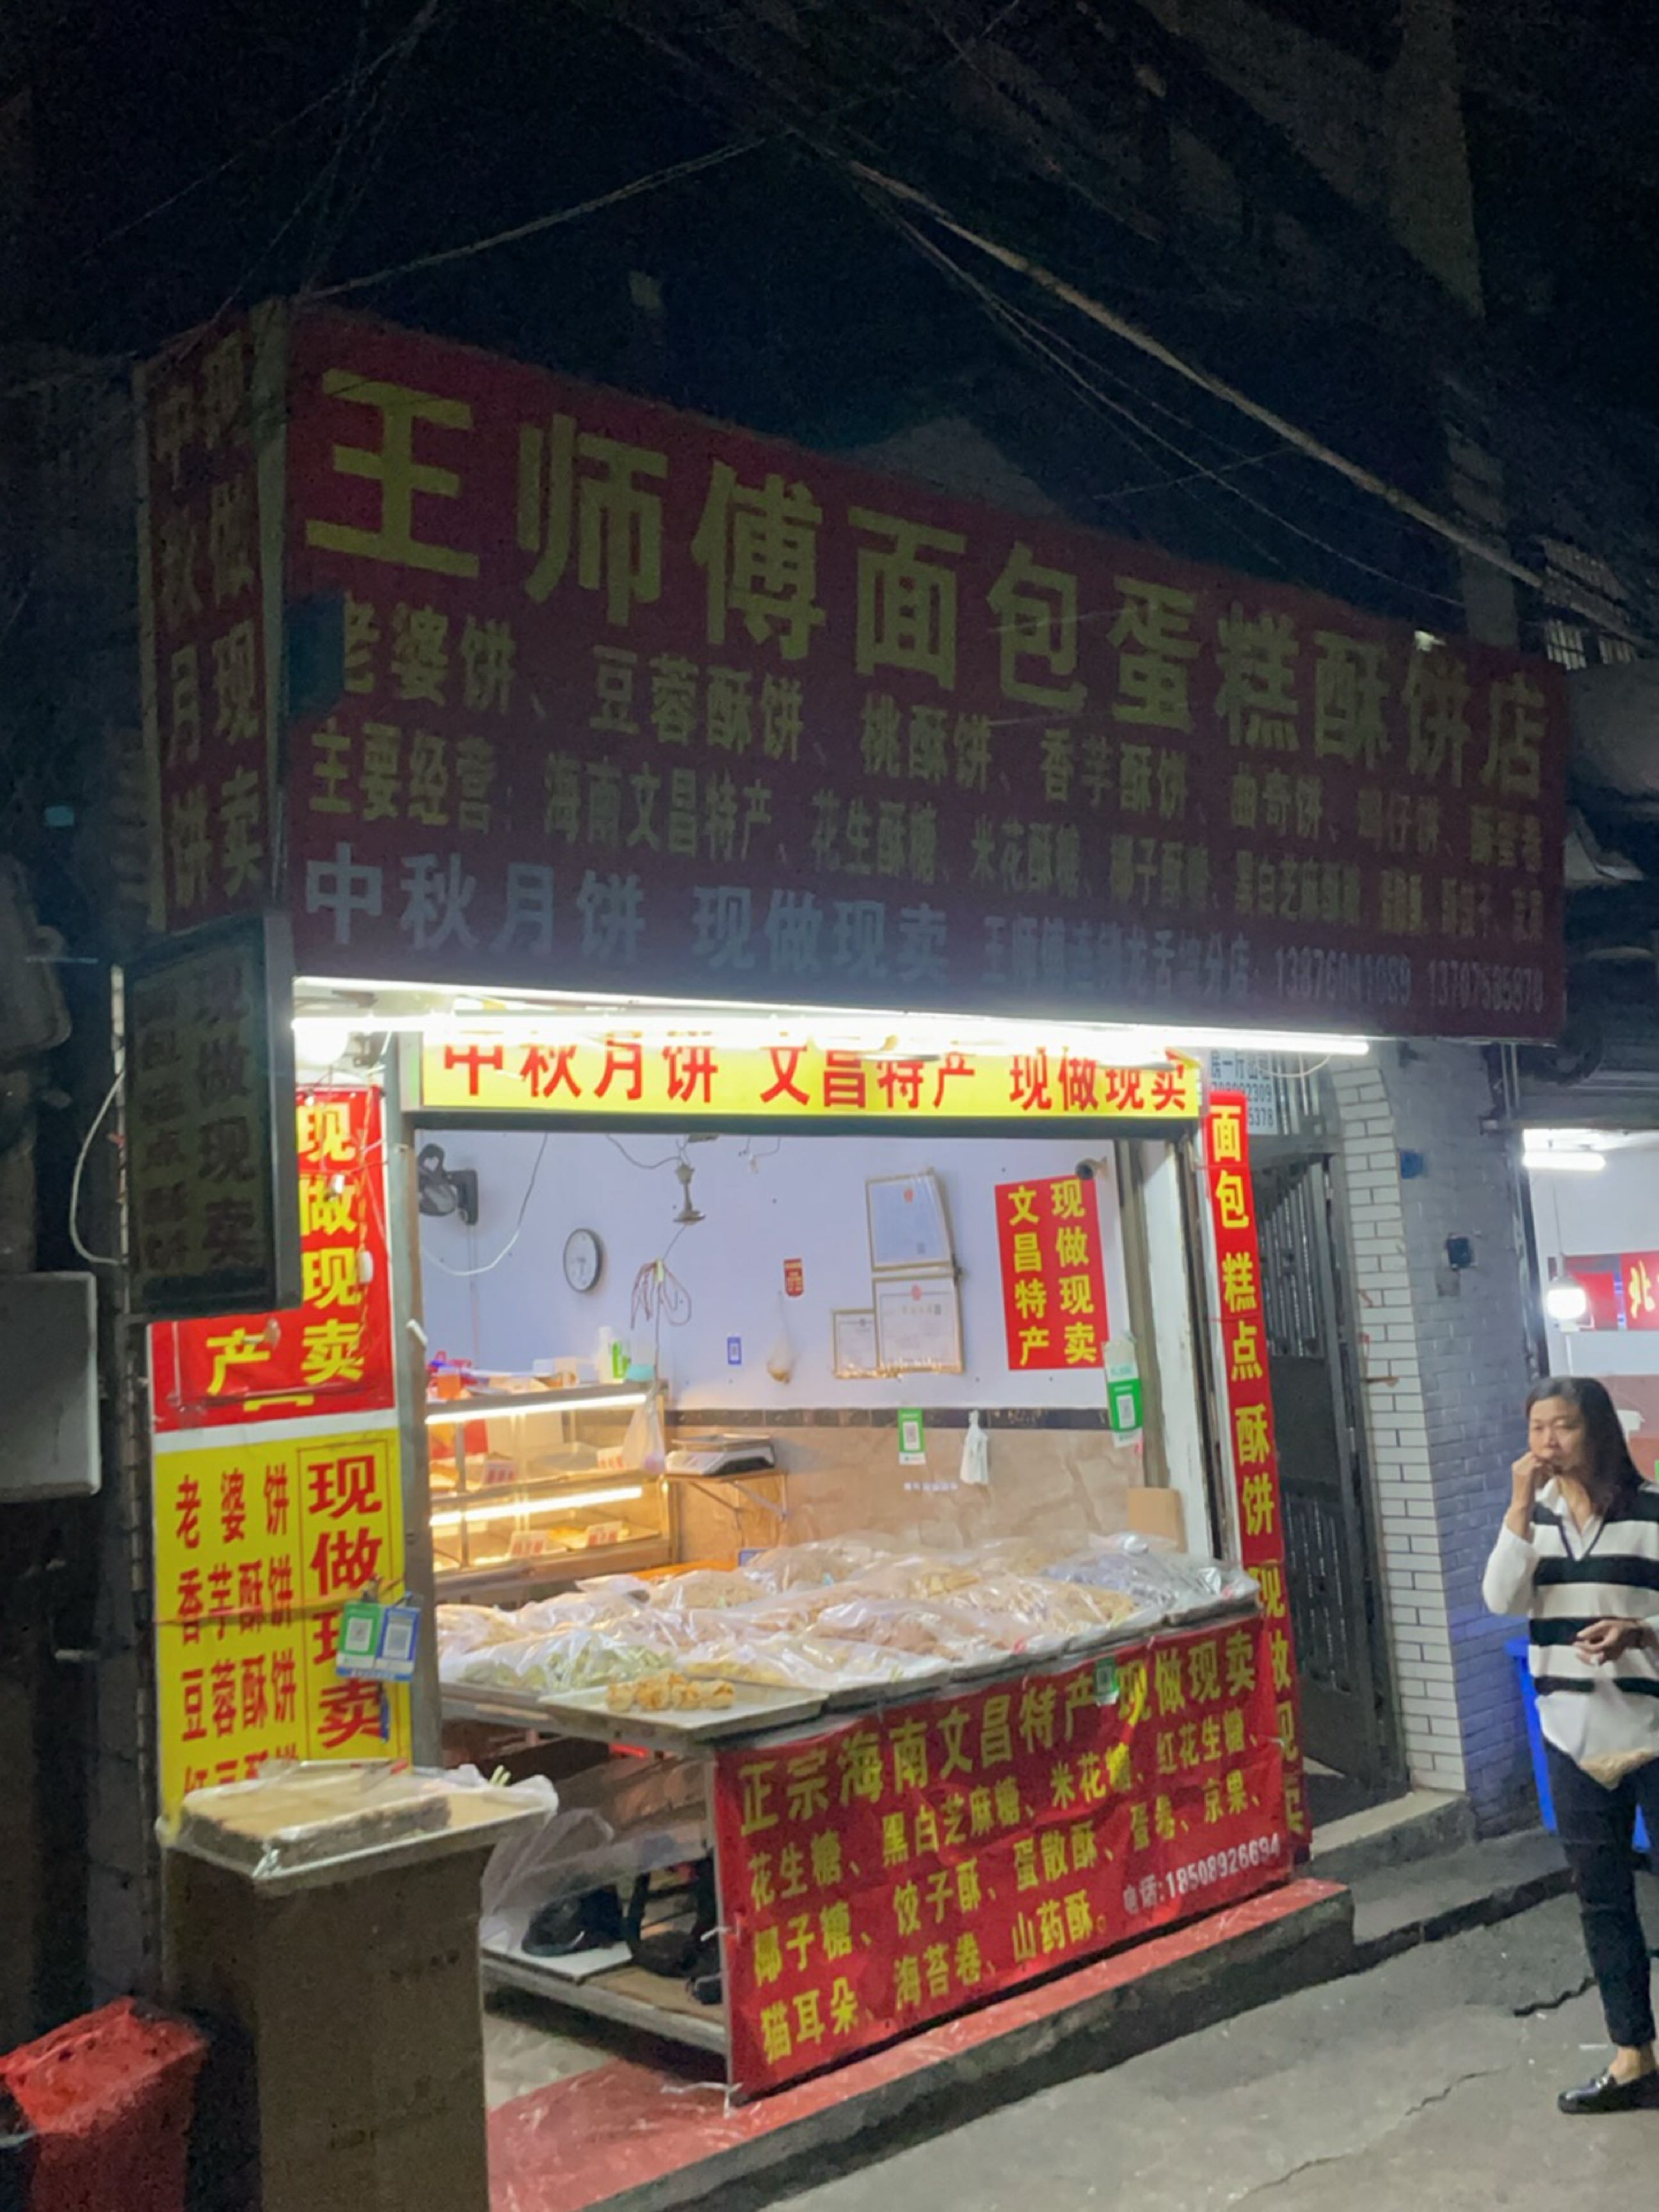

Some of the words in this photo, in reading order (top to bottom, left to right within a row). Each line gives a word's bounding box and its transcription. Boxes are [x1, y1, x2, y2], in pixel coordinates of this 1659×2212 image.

[306, 367, 1544, 797] 王师傅面包蛋糕酥饼店
[305, 841, 646, 961] 中秋月饼
[693, 883, 949, 986] 现做现卖
[443, 1032, 719, 1104] 中秋月饼
[760, 1041, 975, 1109] 文昌特产
[1210, 1105, 1249, 1228] 面包
[1008, 1185, 1050, 1366] 文昌特产
[1050, 1178, 1097, 1365] 现做现卖
[1221, 1252, 1263, 1382] 糕点
[176, 1463, 290, 1550] 老婆饼
[1234, 1404, 1276, 1534] 酥饼
[177, 1553, 293, 1646] 香芋酥饼
[181, 1647, 297, 1742] 豆蓉酥饼
[738, 1671, 1093, 1836] 正宗海南文昌特产
[1116, 1630, 1256, 1726] 现做现卖
